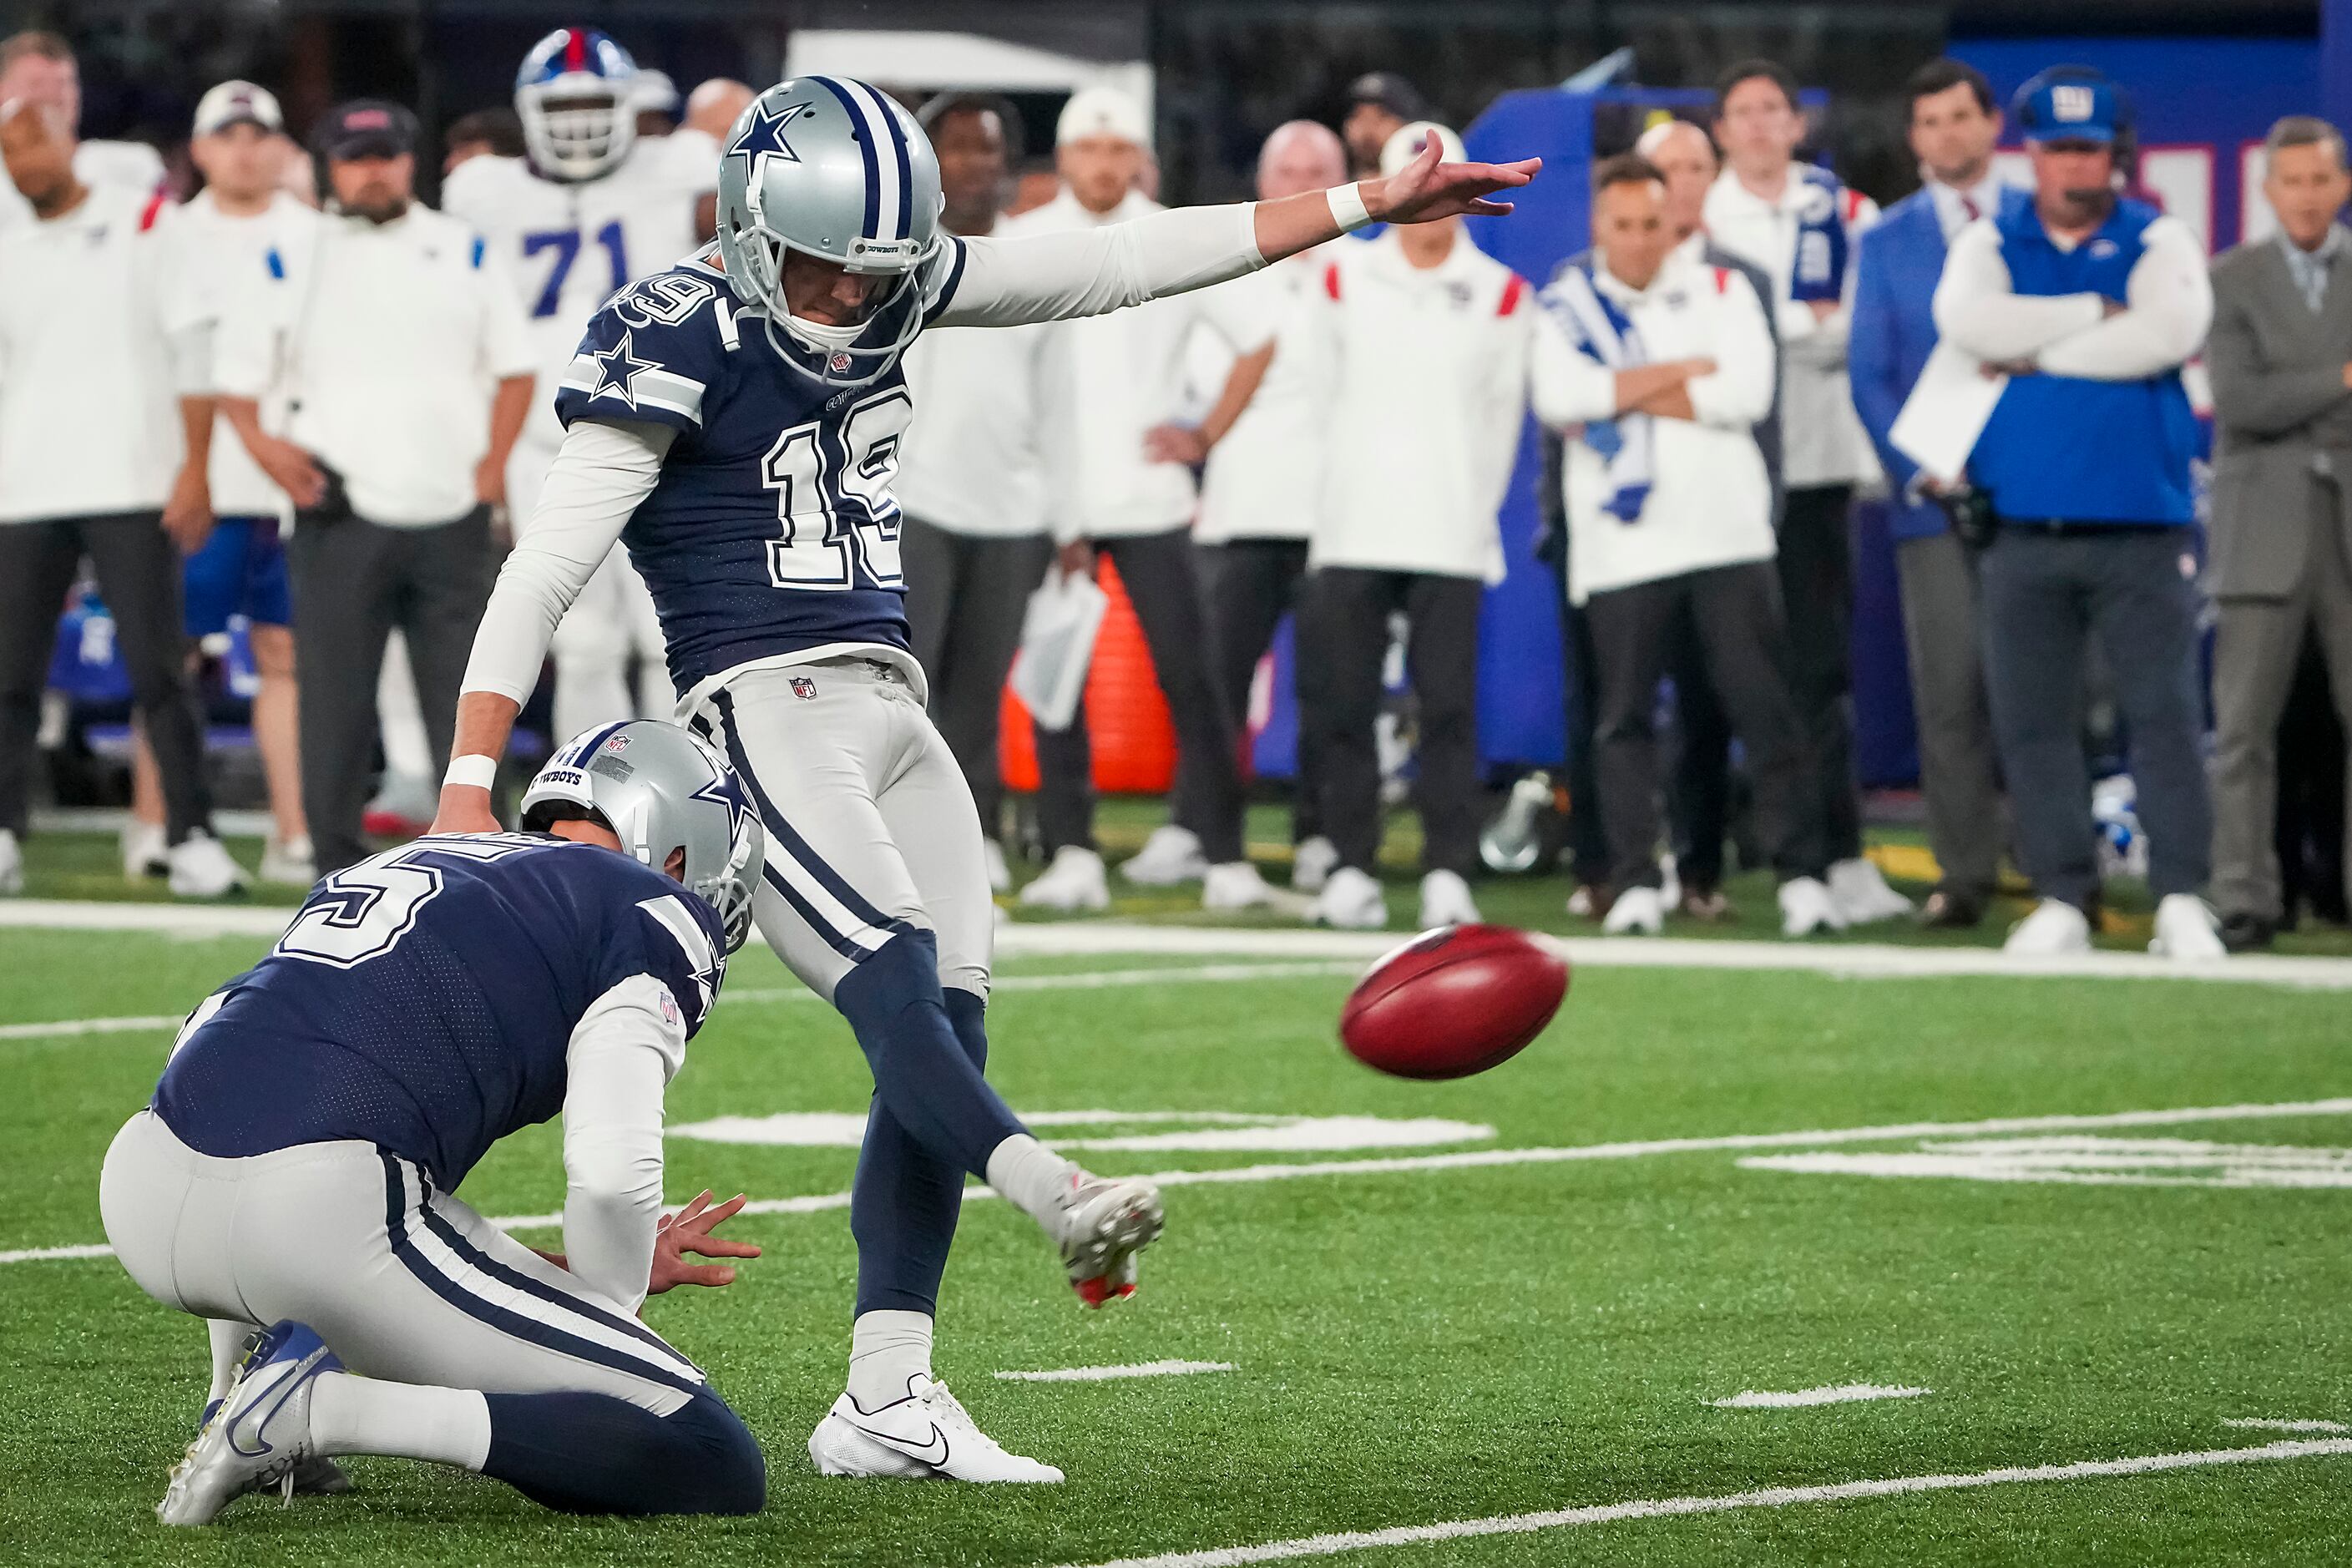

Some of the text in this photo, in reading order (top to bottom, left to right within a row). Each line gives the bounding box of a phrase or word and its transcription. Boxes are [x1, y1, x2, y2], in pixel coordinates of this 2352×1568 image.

[524, 220, 629, 318] 71
[761, 386, 913, 590] 19
[272, 839, 534, 969] 5
